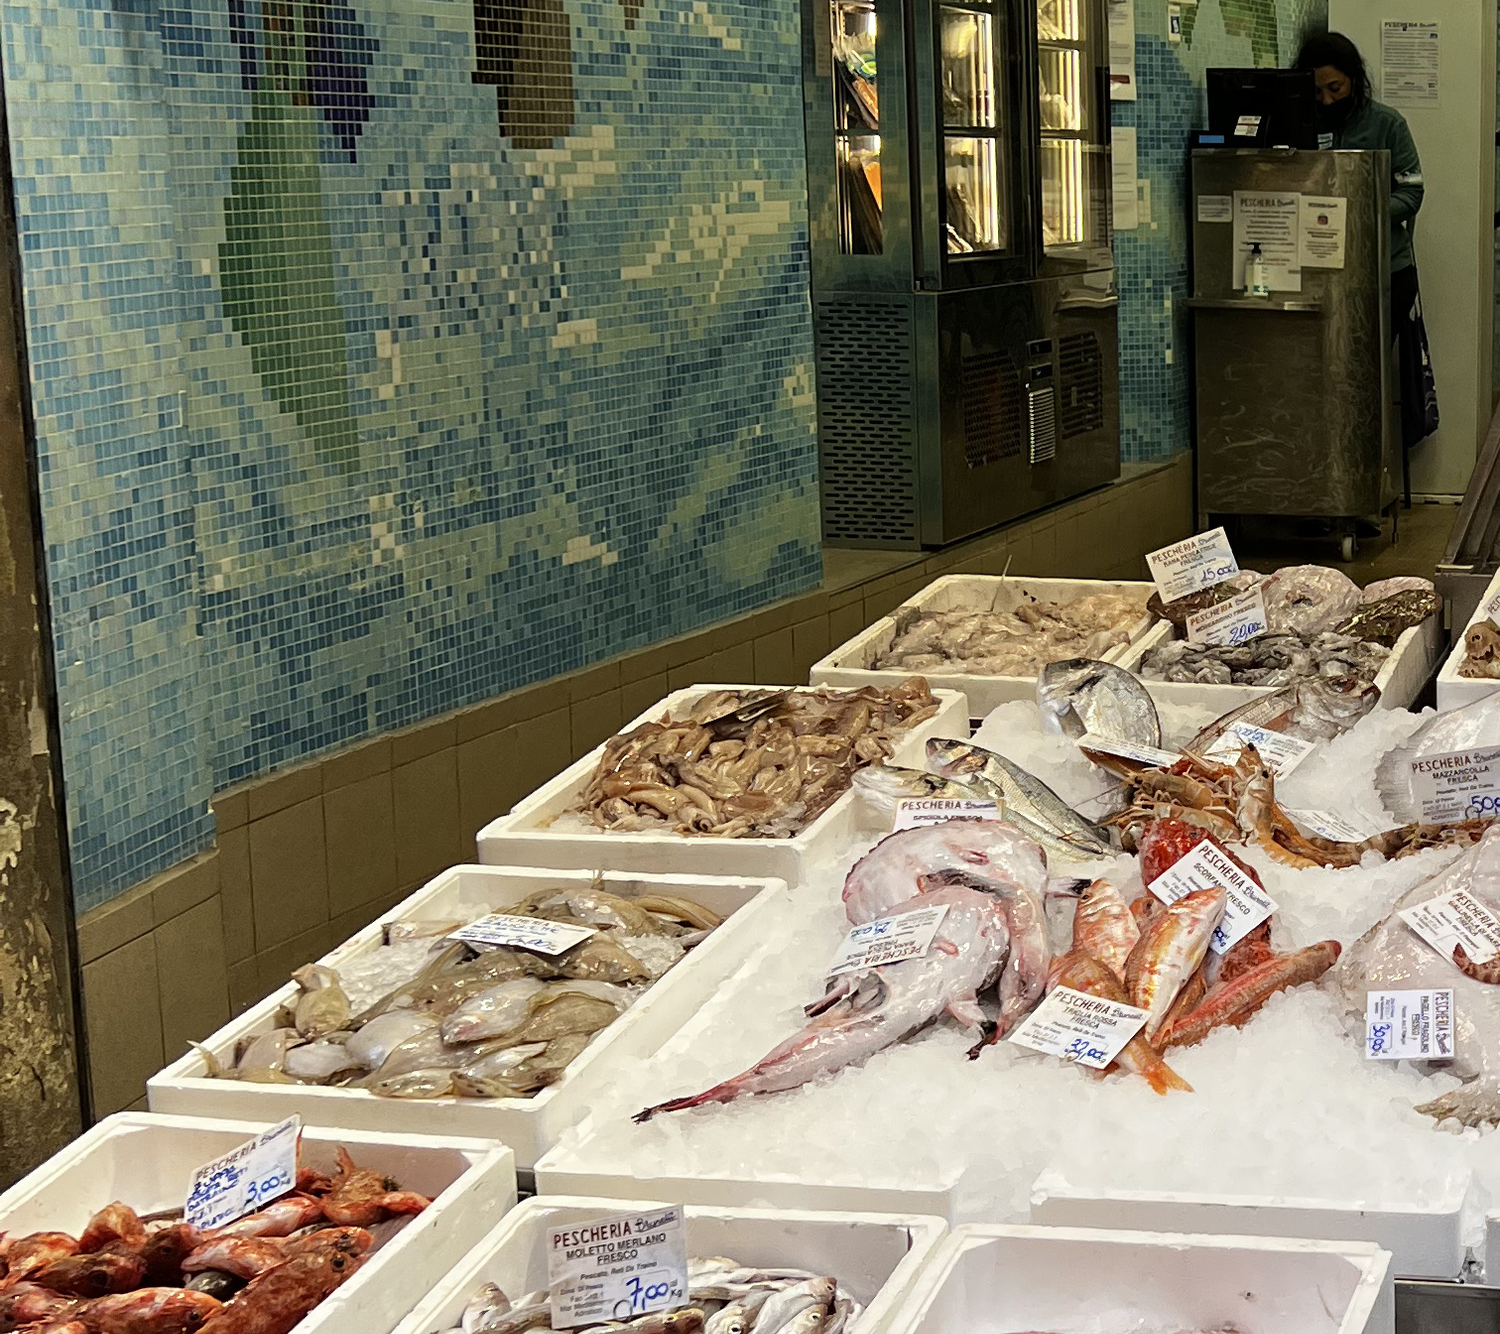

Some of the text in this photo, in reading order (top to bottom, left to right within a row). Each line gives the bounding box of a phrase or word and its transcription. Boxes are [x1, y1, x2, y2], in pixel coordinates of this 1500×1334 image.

[1151, 541, 1198, 565] PESCHERIA
[1189, 602, 1233, 626] PESCHERIA
[1411, 755, 1472, 774] PESCHERIA
[901, 800, 962, 810] PESCHERIA
[1198, 844, 1246, 890] PESCHERIA
[1226, 890, 1251, 916] FRESCO
[1453, 892, 1496, 930] PESCHERIA
[864, 945, 923, 965] PESCHERIA
[1055, 990, 1111, 1015] PESCHERIA
[1435, 992, 1450, 1032] PESCHERIA
[196, 1141, 257, 1180] PESCHERIA
[553, 1220, 632, 1249] PESCHERIA
[566, 1232, 667, 1261] MOLETTO MERLANO
[597, 1249, 639, 1266] FRESCO
[626, 1277, 670, 1311] 7,00
